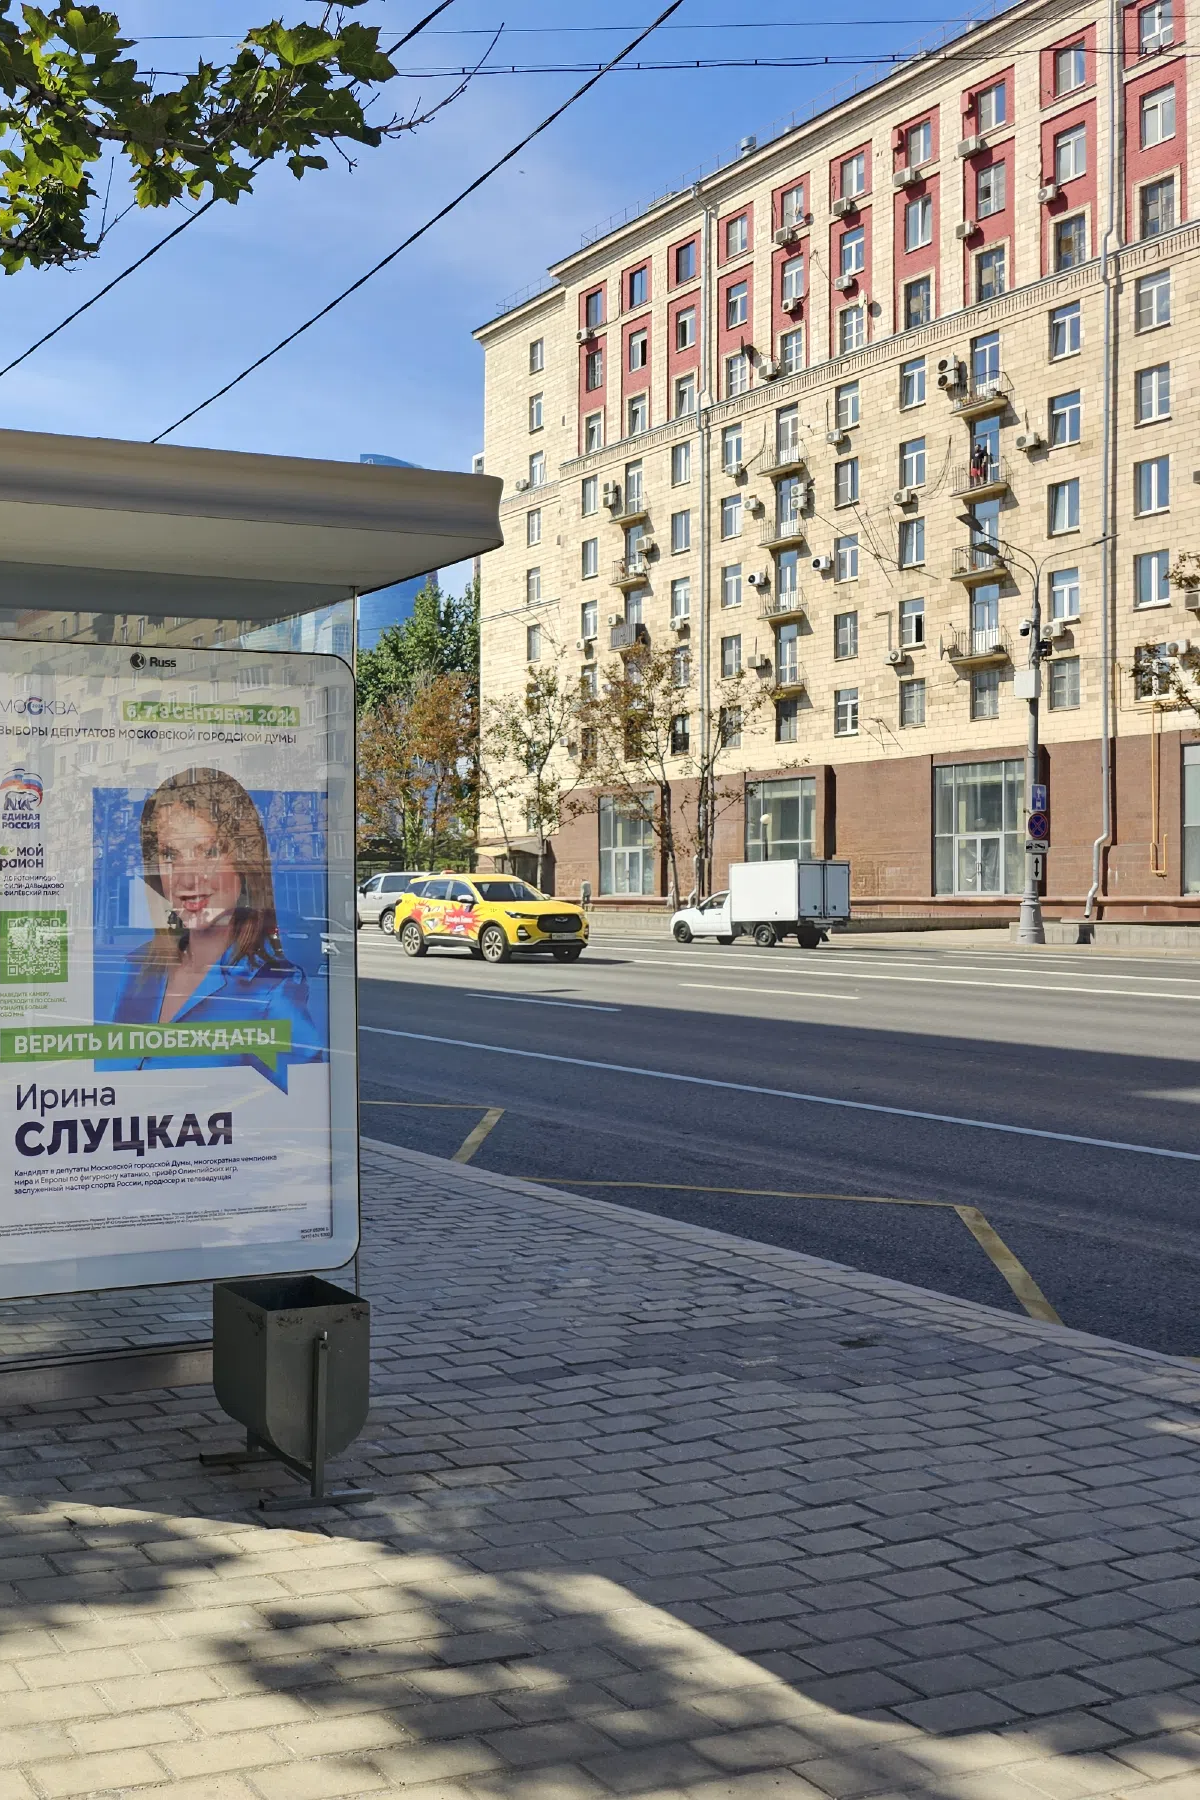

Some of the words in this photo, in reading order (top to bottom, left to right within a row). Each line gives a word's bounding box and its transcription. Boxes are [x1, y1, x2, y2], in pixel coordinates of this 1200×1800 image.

[150, 656, 176, 668] Russ
[160, 706, 170, 719] 8
[173, 706, 253, 722] СЕНТЯБРЯ
[257, 709, 296, 723] 2024
[50, 727, 116, 738] ДЕПУТАТОВ
[118, 728, 196, 741] МОСКОВСКОЙ
[198, 730, 262, 744] ГОРОДСКОЙ
[264, 734, 296, 744] ДУМЫ
[14, 1032, 102, 1054] ВЕРИТЬ
[108, 1030, 124, 1050] И
[130, 1027, 276, 1051] ПОБЕЖДАТЬ!
[16, 1084, 116, 1117] Ирина
[14, 1112, 233, 1157] СЛУЦКАЯ
[56, 1166, 89, 1174] депутаты
[91, 1163, 132, 1171] Московской
[134, 1161, 170, 1170] городской
[194, 1157, 239, 1165] многократная
[80, 1173, 118, 1182] фигурному
[178, 1166, 224, 1174] Олимпийских
[14, 1185, 64, 1195] заслуженный
[144, 1177, 180, 1186] продюсер
